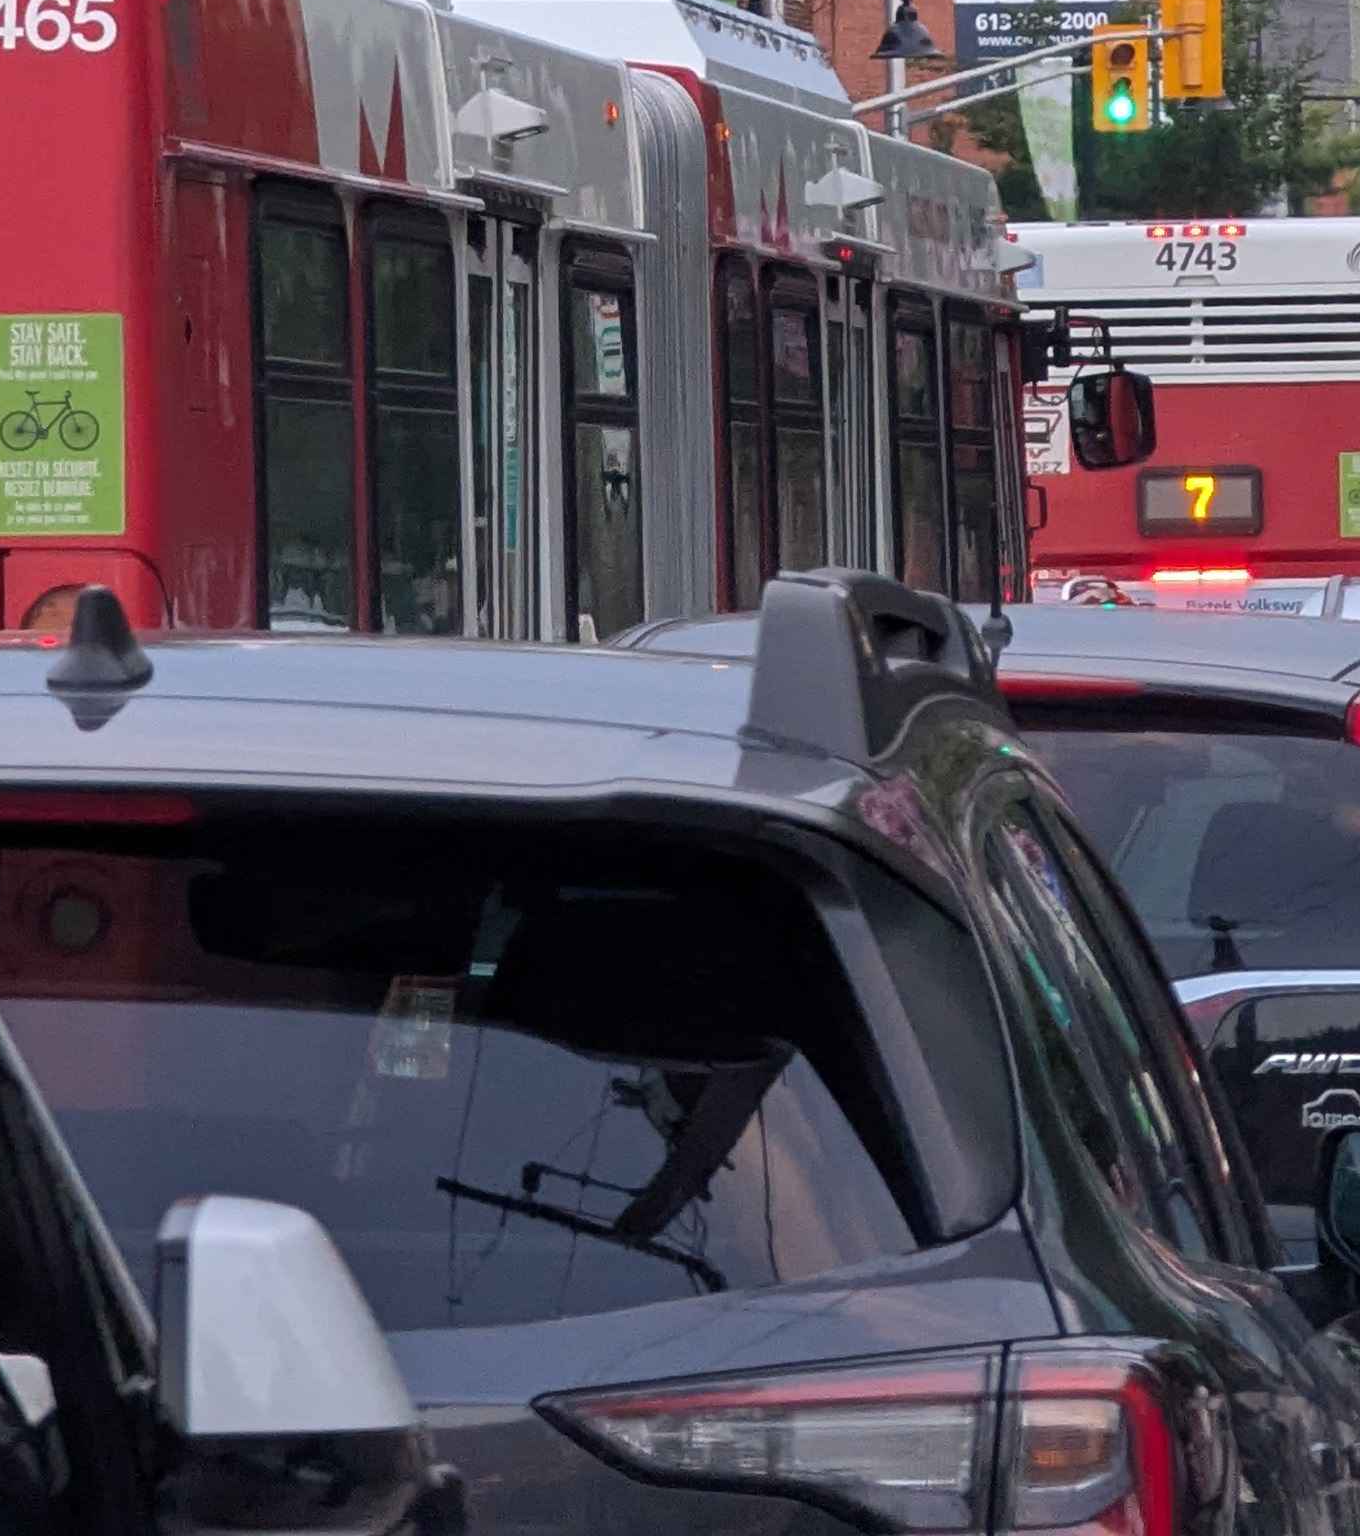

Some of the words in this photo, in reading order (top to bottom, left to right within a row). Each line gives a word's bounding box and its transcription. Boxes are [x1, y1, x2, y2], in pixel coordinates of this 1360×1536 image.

[1155, 242, 1237, 272] 4743
[10, 322, 42, 343] STAY
[48, 321, 87, 343] SAFE.
[10, 344, 42, 367] STAY
[48, 344, 88, 367] BACK.
[1185, 476, 1216, 519] 7
